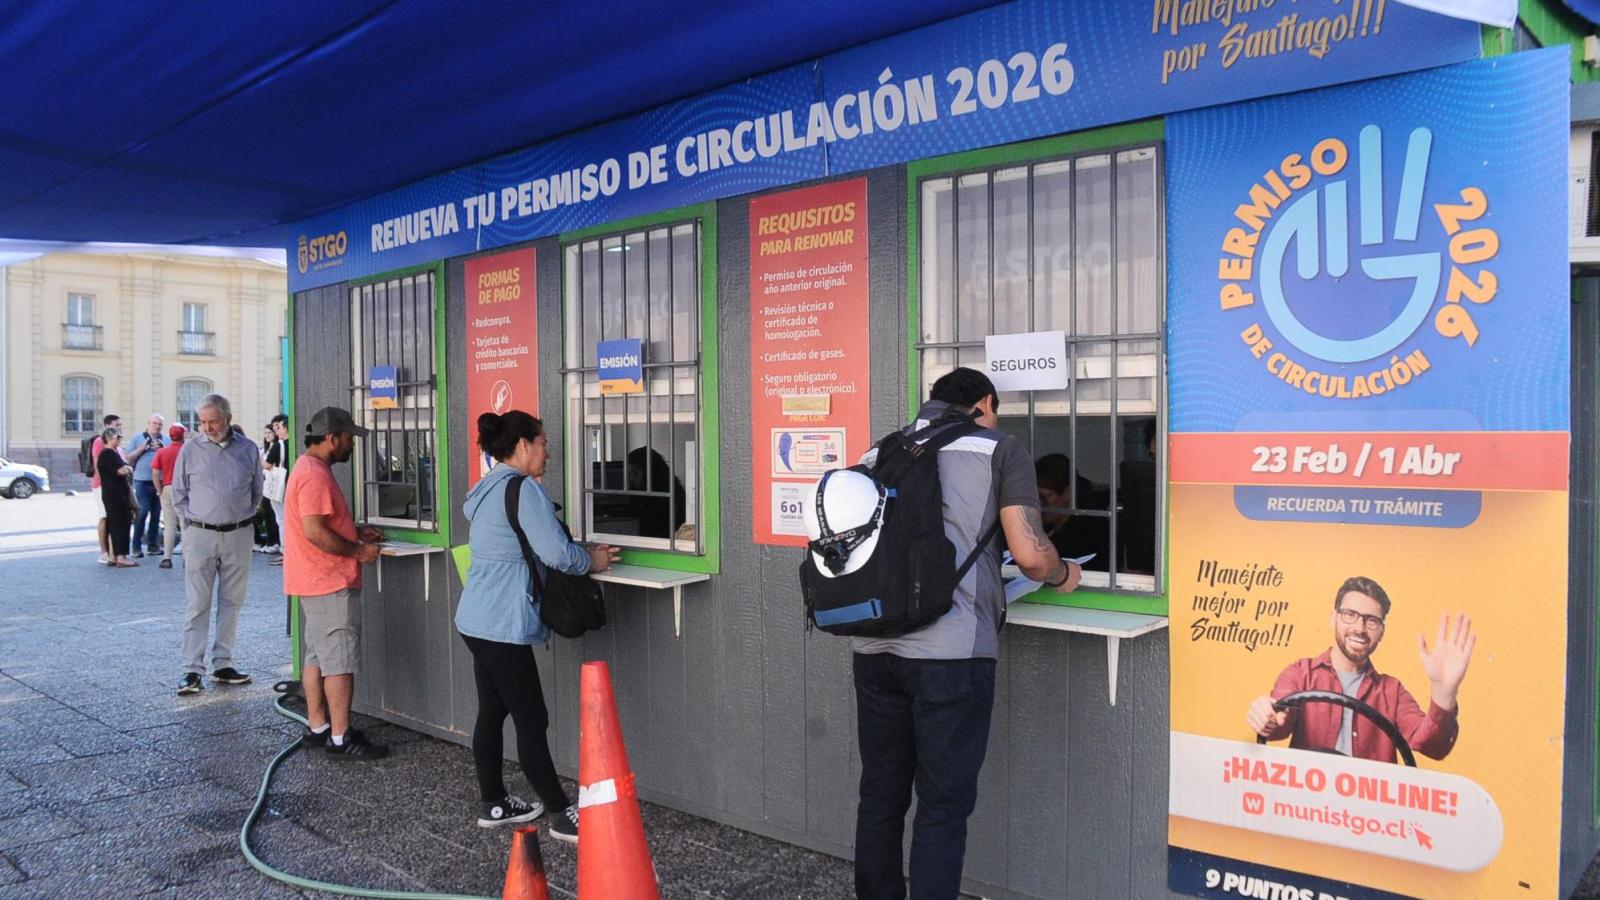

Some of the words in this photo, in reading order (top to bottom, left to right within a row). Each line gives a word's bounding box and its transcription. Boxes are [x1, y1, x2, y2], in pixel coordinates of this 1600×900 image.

[1162, 43, 1206, 84] por
[371, 203, 459, 252] RENUEVA
[463, 192, 496, 229] TU
[501, 158, 621, 220] PERMISO
[628, 145, 668, 190] DE
[676, 67, 938, 177] CIRCULACIÓN
[946, 43, 1075, 116] 2026
[758, 202, 856, 235] REQUISITOS
[1218, 137, 1348, 310] PERMISO
[309, 231, 347, 263] STGO
[760, 239, 792, 256] PARA
[794, 229, 854, 251] RENOVAR
[763, 269, 795, 283] Permiso
[797, 268, 807, 278] de
[808, 261, 853, 276] circulación
[1433, 186, 1500, 347] 2026
[479, 267, 520, 288] FORMAS
[764, 283, 779, 295] año
[780, 280, 812, 294] anterior
[814, 275, 847, 290] original.
[478, 289, 492, 305] DE
[493, 285, 521, 302] PAGO
[764, 303, 796, 316] Revisión
[798, 300, 827, 312] técnica
[828, 301, 834, 309] o
[475, 315, 512, 328] Redcompra.
[764, 316, 807, 328] certificado
[807, 315, 818, 324] de
[476, 336, 500, 348] Tarjetas
[501, 334, 509, 344] de
[765, 326, 822, 340] homologación.
[475, 346, 497, 359] crédito
[498, 344, 529, 357] bancarias
[600, 353, 639, 369] EMISIÓN
[764, 350, 807, 362] Certificado
[808, 349, 819, 359] de
[820, 349, 846, 361] gases.
[1240, 323, 1273, 359] DE
[1266, 349, 1431, 399] CIRCULACIÓN
[480, 358, 519, 370] comerciales.
[991, 357, 1057, 372] SEGUROS
[764, 374, 792, 386] Seguro
[793, 370, 838, 384] obligatorio
[806, 382, 858, 395] electrónico).
[1250, 445, 1287, 473] 23
[1292, 444, 1348, 475] Feb
[1353, 442, 1372, 477] /
[1378, 446, 1397, 474] 1
[1399, 443, 1462, 475] Abr
[781, 501, 788, 513] 6
[1267, 496, 1346, 513] RECUERDA
[1350, 499, 1371, 514] TU
[1374, 496, 1443, 517] TRÁMITE
[1196, 559, 1285, 592] Manéjate
[1192, 591, 1246, 618] mejor
[1254, 599, 1289, 621] por
[1190, 617, 1294, 653] Santiago!!!
[1223, 756, 1327, 792] ¡HAZLO
[1334, 772, 1459, 817] ONLINE!
[1273, 801, 1407, 839] munistgo.cl
[1205, 868, 1221, 888] 9
